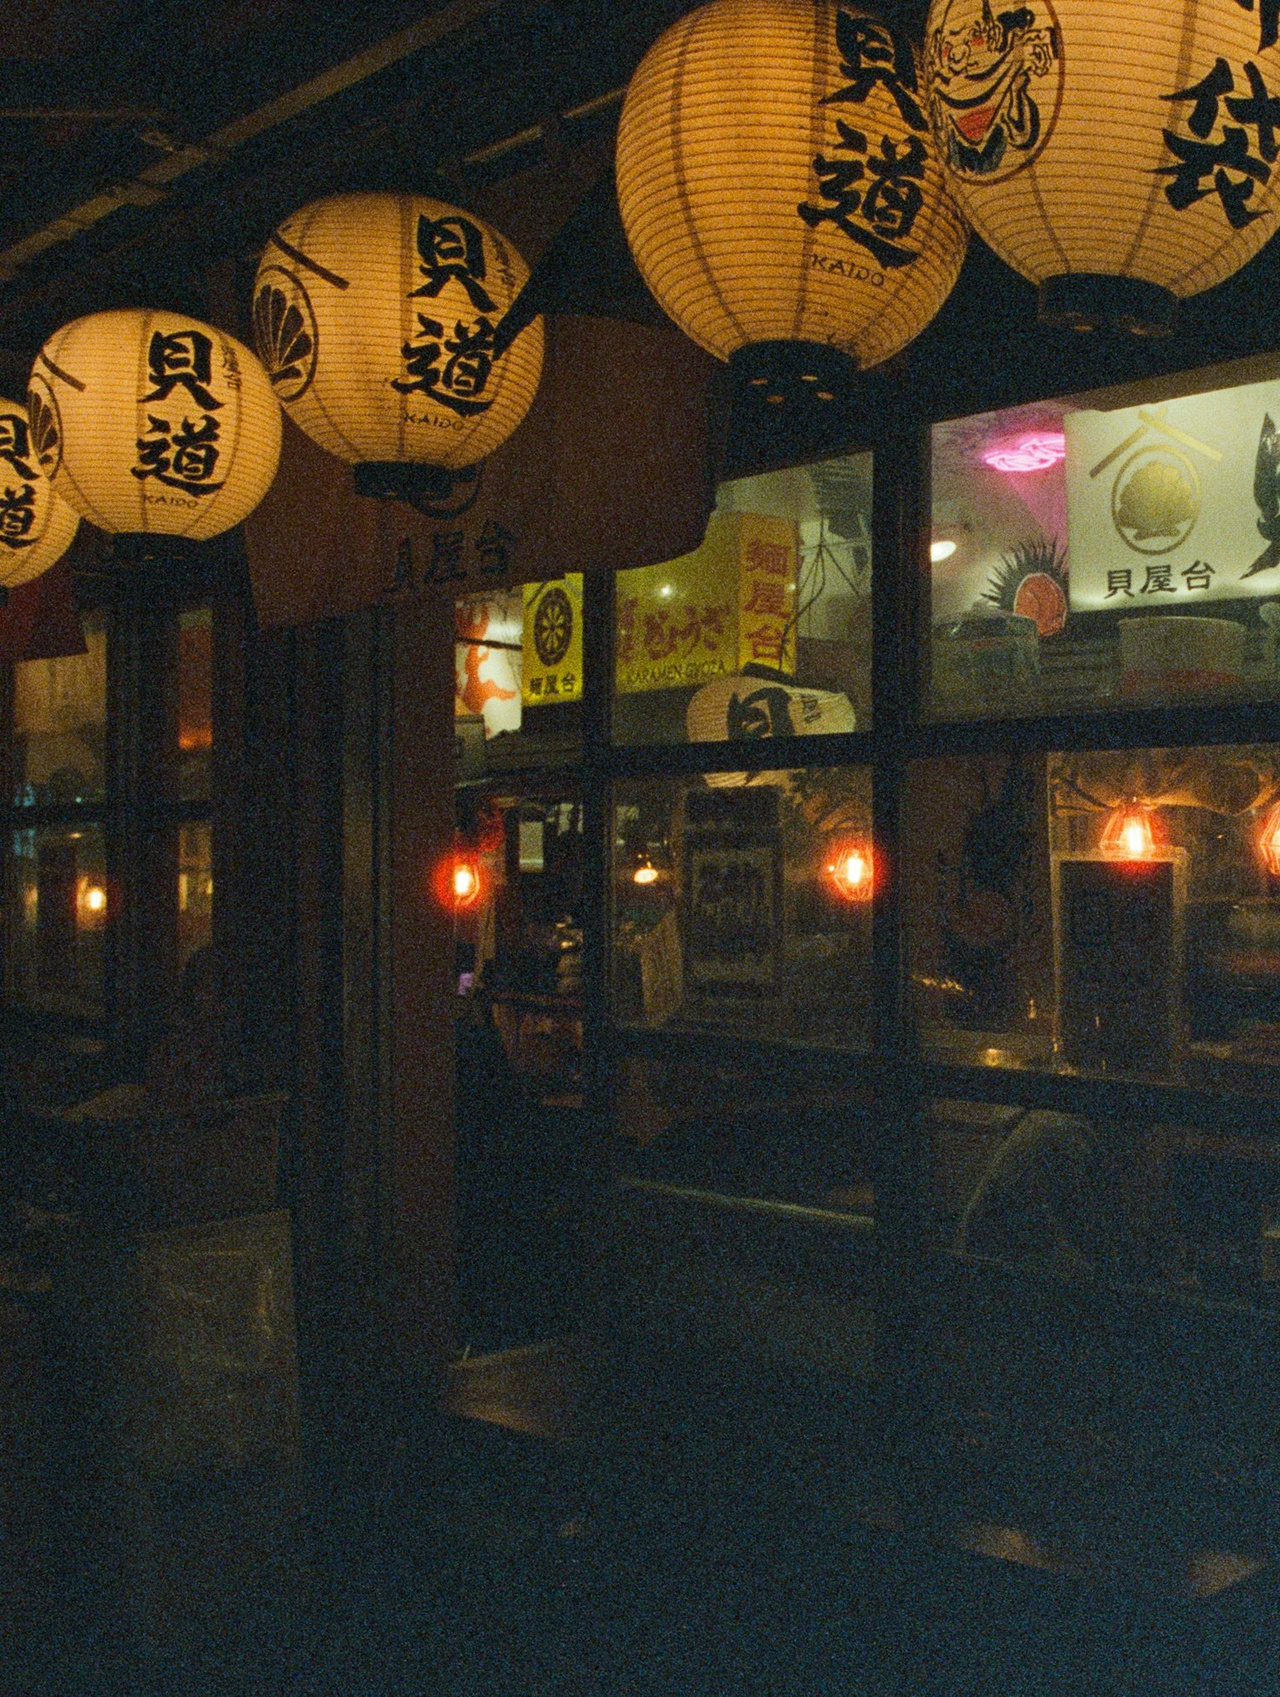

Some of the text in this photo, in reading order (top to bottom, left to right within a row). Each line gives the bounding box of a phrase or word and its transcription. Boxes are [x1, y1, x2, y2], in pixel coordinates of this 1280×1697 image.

[813, 254, 886, 290] KAIDO
[131, 329, 225, 498] 貝道
[403, 410, 467, 433] KAIDO
[144, 492, 201, 509] KAIDO
[1103, 559, 1217, 600] 貝屋台
